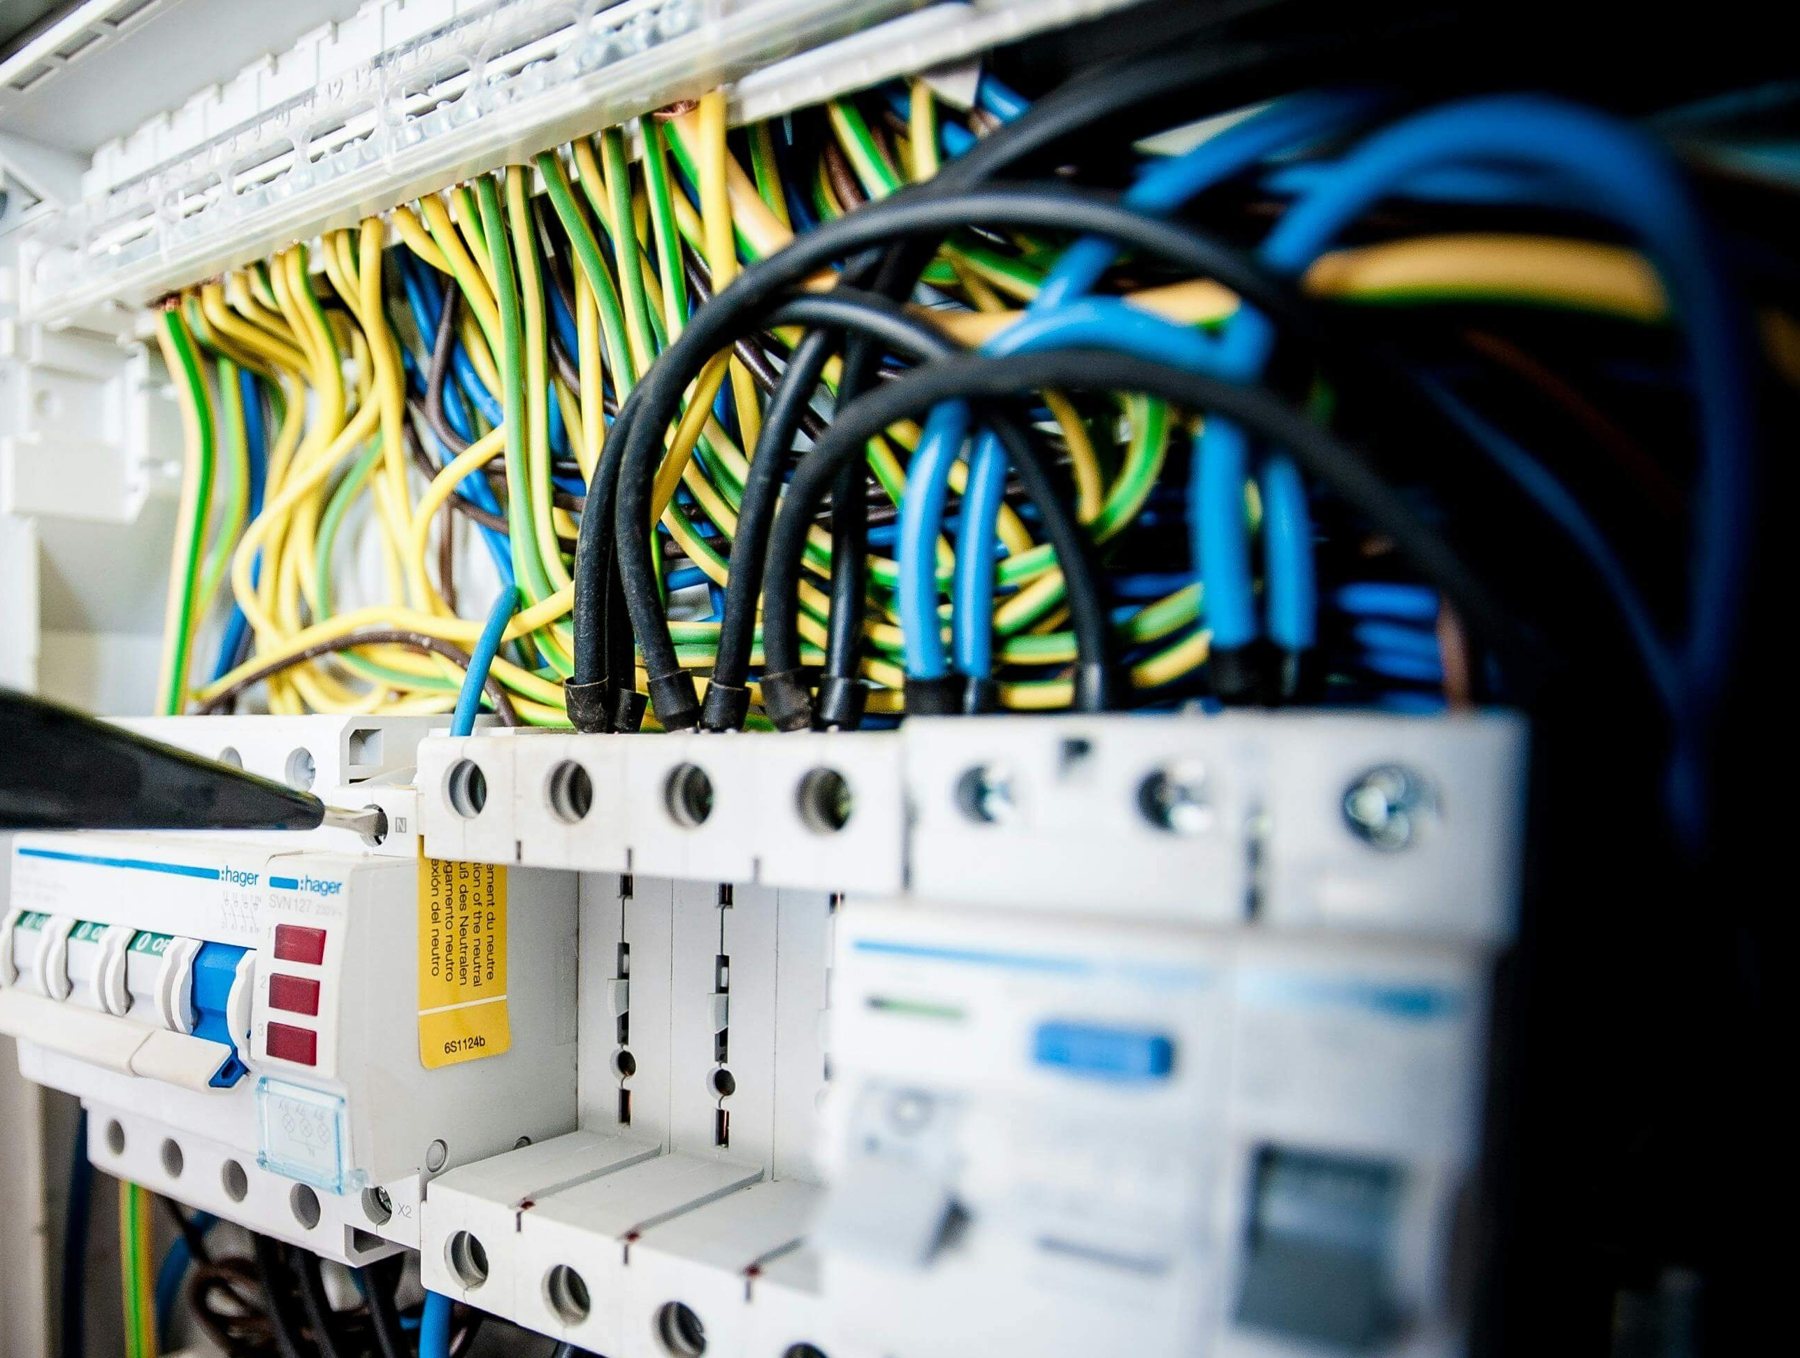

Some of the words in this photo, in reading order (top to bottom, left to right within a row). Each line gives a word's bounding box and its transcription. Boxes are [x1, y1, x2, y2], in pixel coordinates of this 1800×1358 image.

[396, 817, 407, 833] N
[459, 884, 469, 912] des
[473, 892, 482, 906] of
[431, 902, 441, 924] del
[473, 911, 483, 934] the
[486, 911, 496, 930] du
[431, 928, 440, 976] neutro
[445, 934, 455, 982] neutro
[459, 915, 469, 986] Neutralen
[473, 937, 482, 987] neutral
[486, 935, 495, 981] neutre
[444, 1035, 485, 1054] 6S1124b
[397, 1202, 412, 1218] X2
